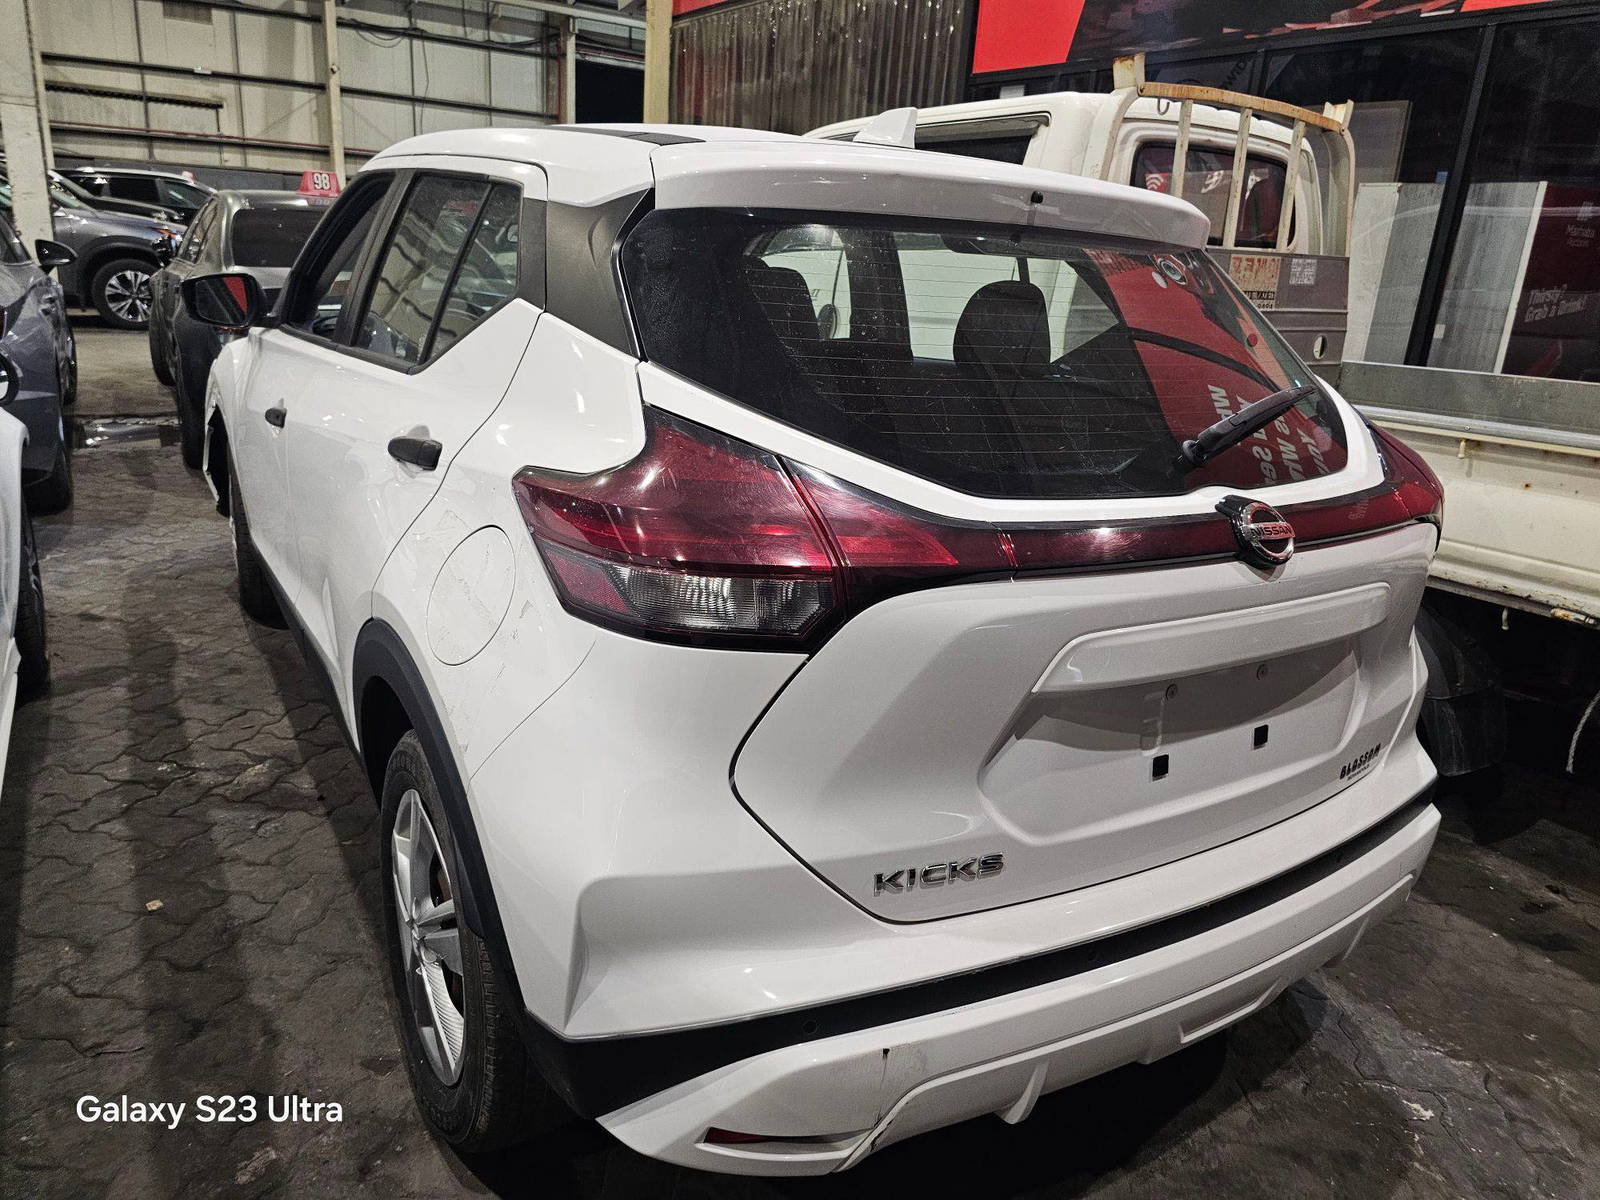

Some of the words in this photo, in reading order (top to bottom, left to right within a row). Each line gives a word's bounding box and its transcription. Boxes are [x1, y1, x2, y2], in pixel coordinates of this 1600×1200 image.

[313, 173, 331, 190] 98
[1250, 525, 1292, 536] NISSAN
[1340, 743, 1382, 780] BLOSSOM
[874, 852, 1003, 894] KICKS
